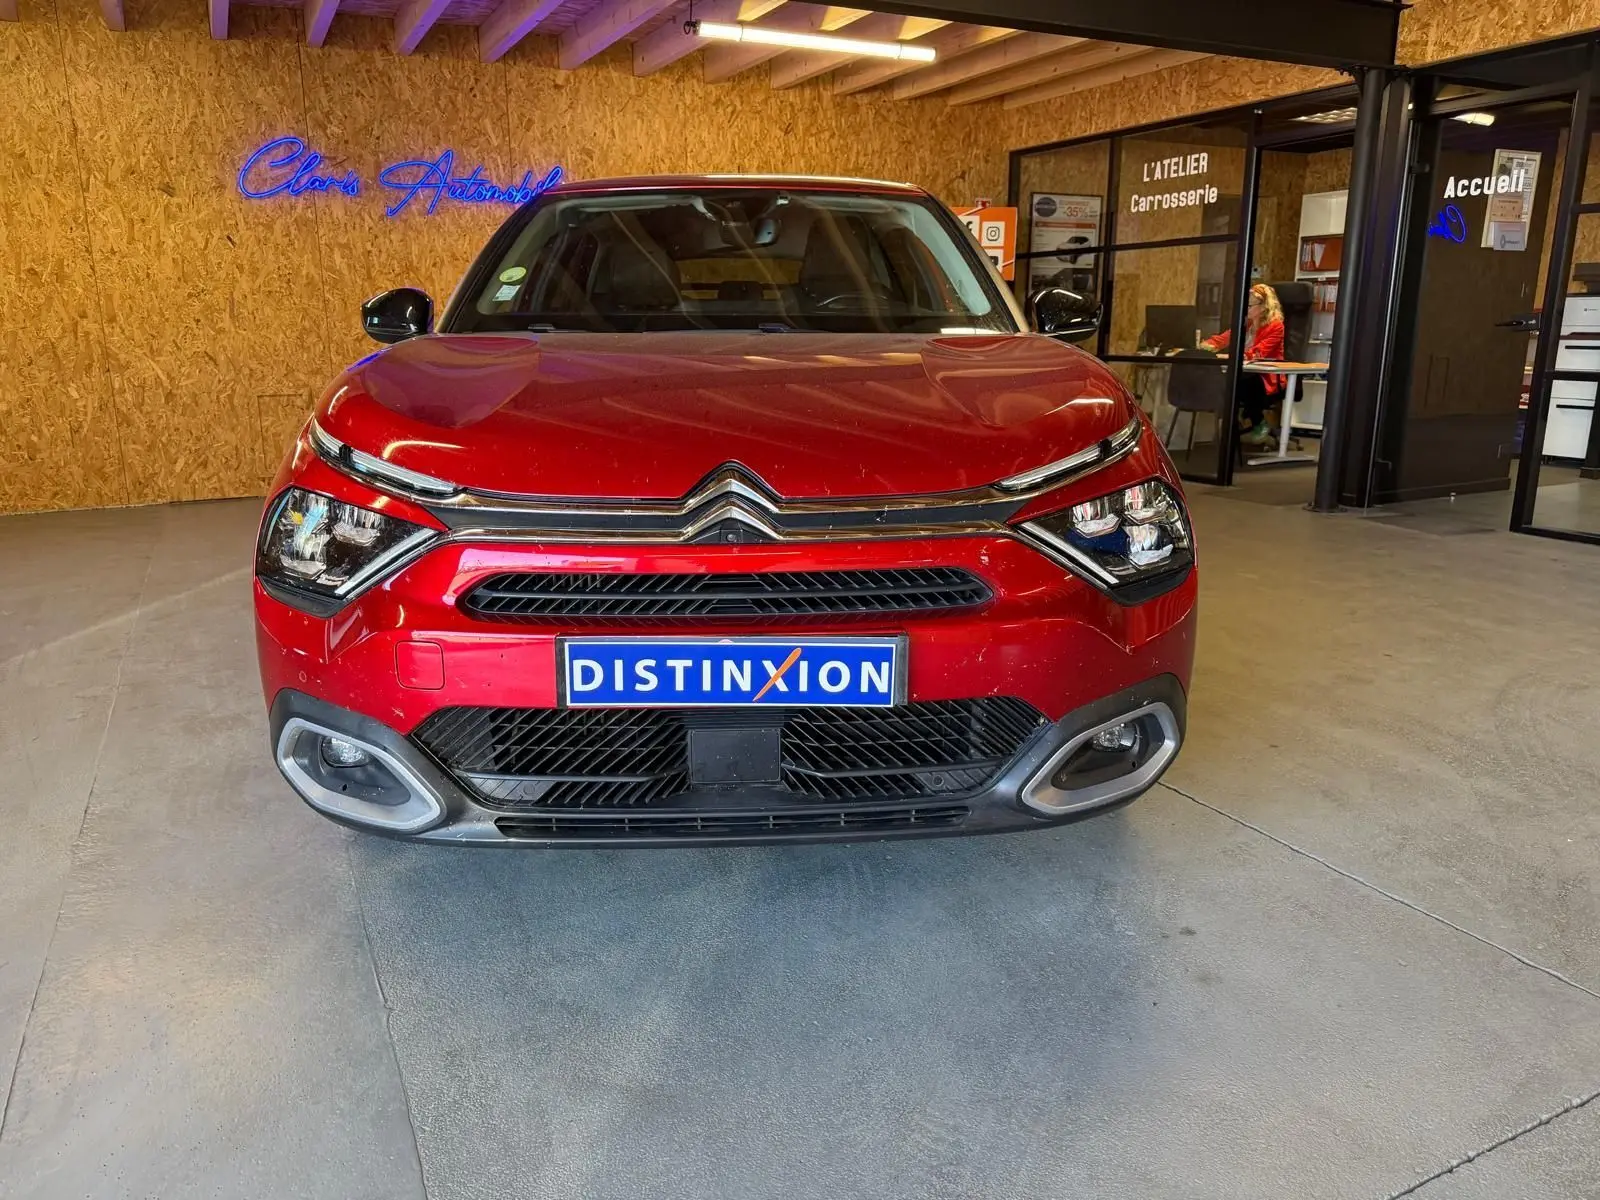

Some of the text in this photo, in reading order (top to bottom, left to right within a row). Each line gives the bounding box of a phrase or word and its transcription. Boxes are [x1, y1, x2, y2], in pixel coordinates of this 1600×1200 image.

[238, 136, 361, 198] Claris
[1142, 152, 1209, 182] L'ATELIER
[1130, 184, 1218, 213] Carrosserie
[1443, 168, 1525, 199] Accueil
[572, 648, 889, 701] DISTINXION
